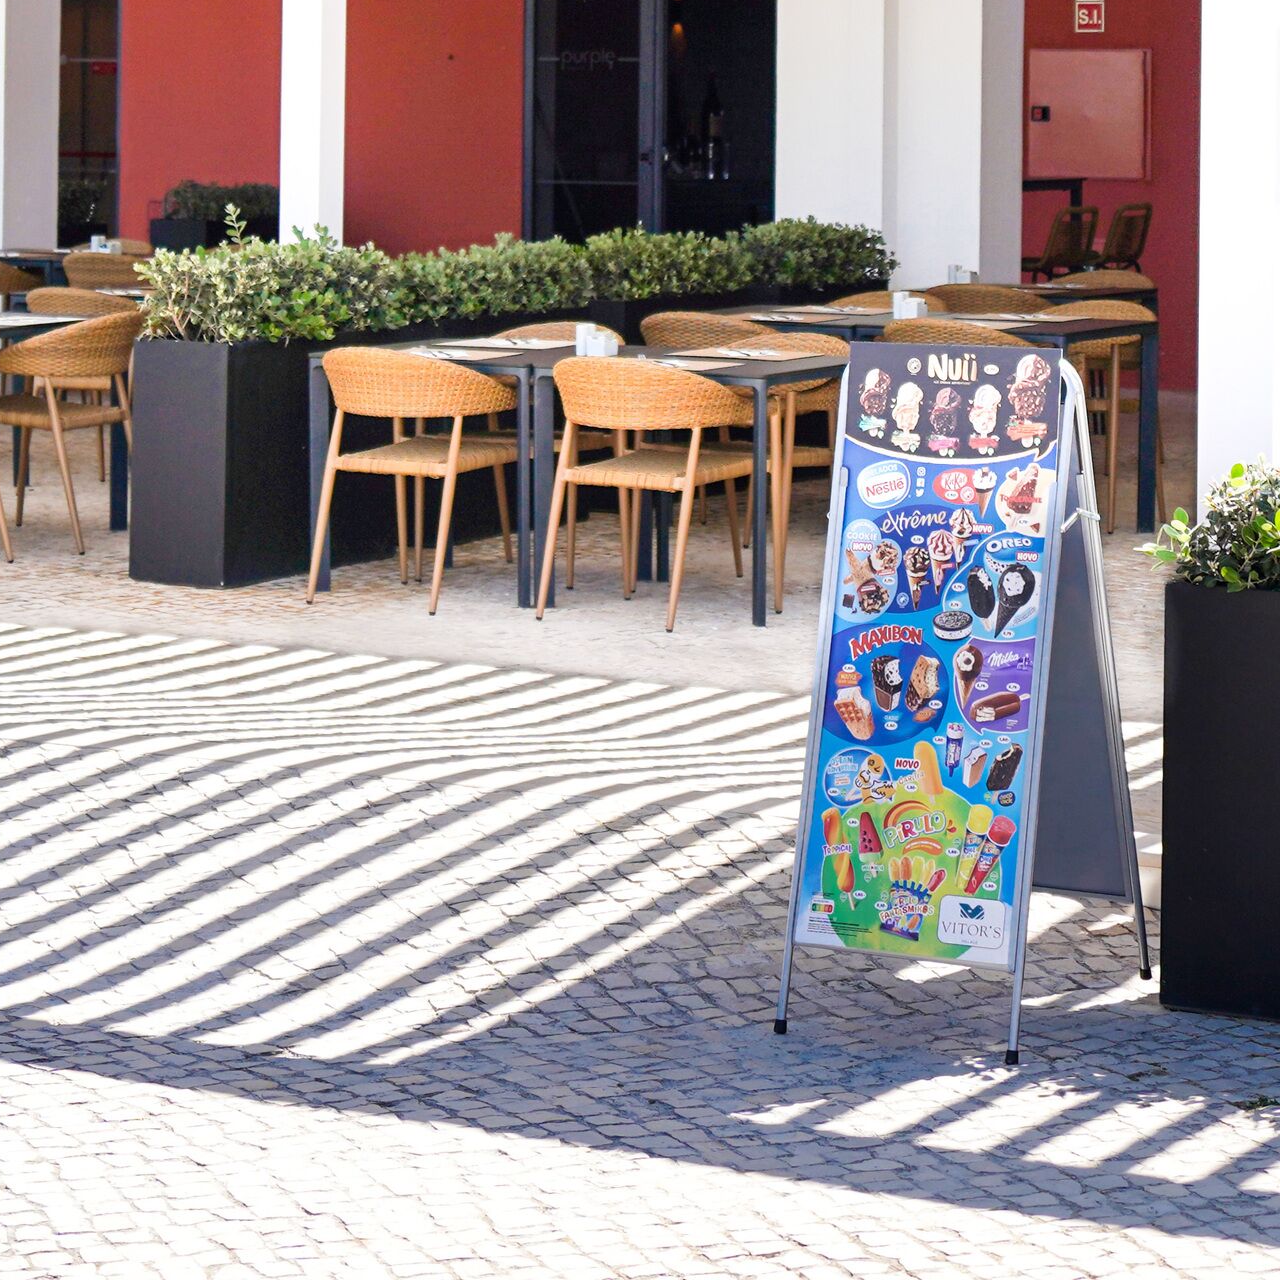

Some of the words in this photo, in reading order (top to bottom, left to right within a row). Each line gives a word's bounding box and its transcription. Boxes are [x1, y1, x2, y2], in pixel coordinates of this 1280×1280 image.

[1078, 8, 1102, 25] S.I.
[928, 353, 978, 382] Nuii
[866, 477, 905, 497] Nestlé
[846, 532, 878, 541] COOKIE
[973, 524, 993, 533] NOVO
[852, 543, 873, 552] NOVO
[986, 537, 1032, 553] OREO
[1017, 552, 1038, 561] NOVO
[849, 625, 923, 661] MAXIBON
[988, 651, 1020, 667] Milka
[896, 758, 920, 769] NOVO
[942, 920, 1001, 939] VITOR'S
